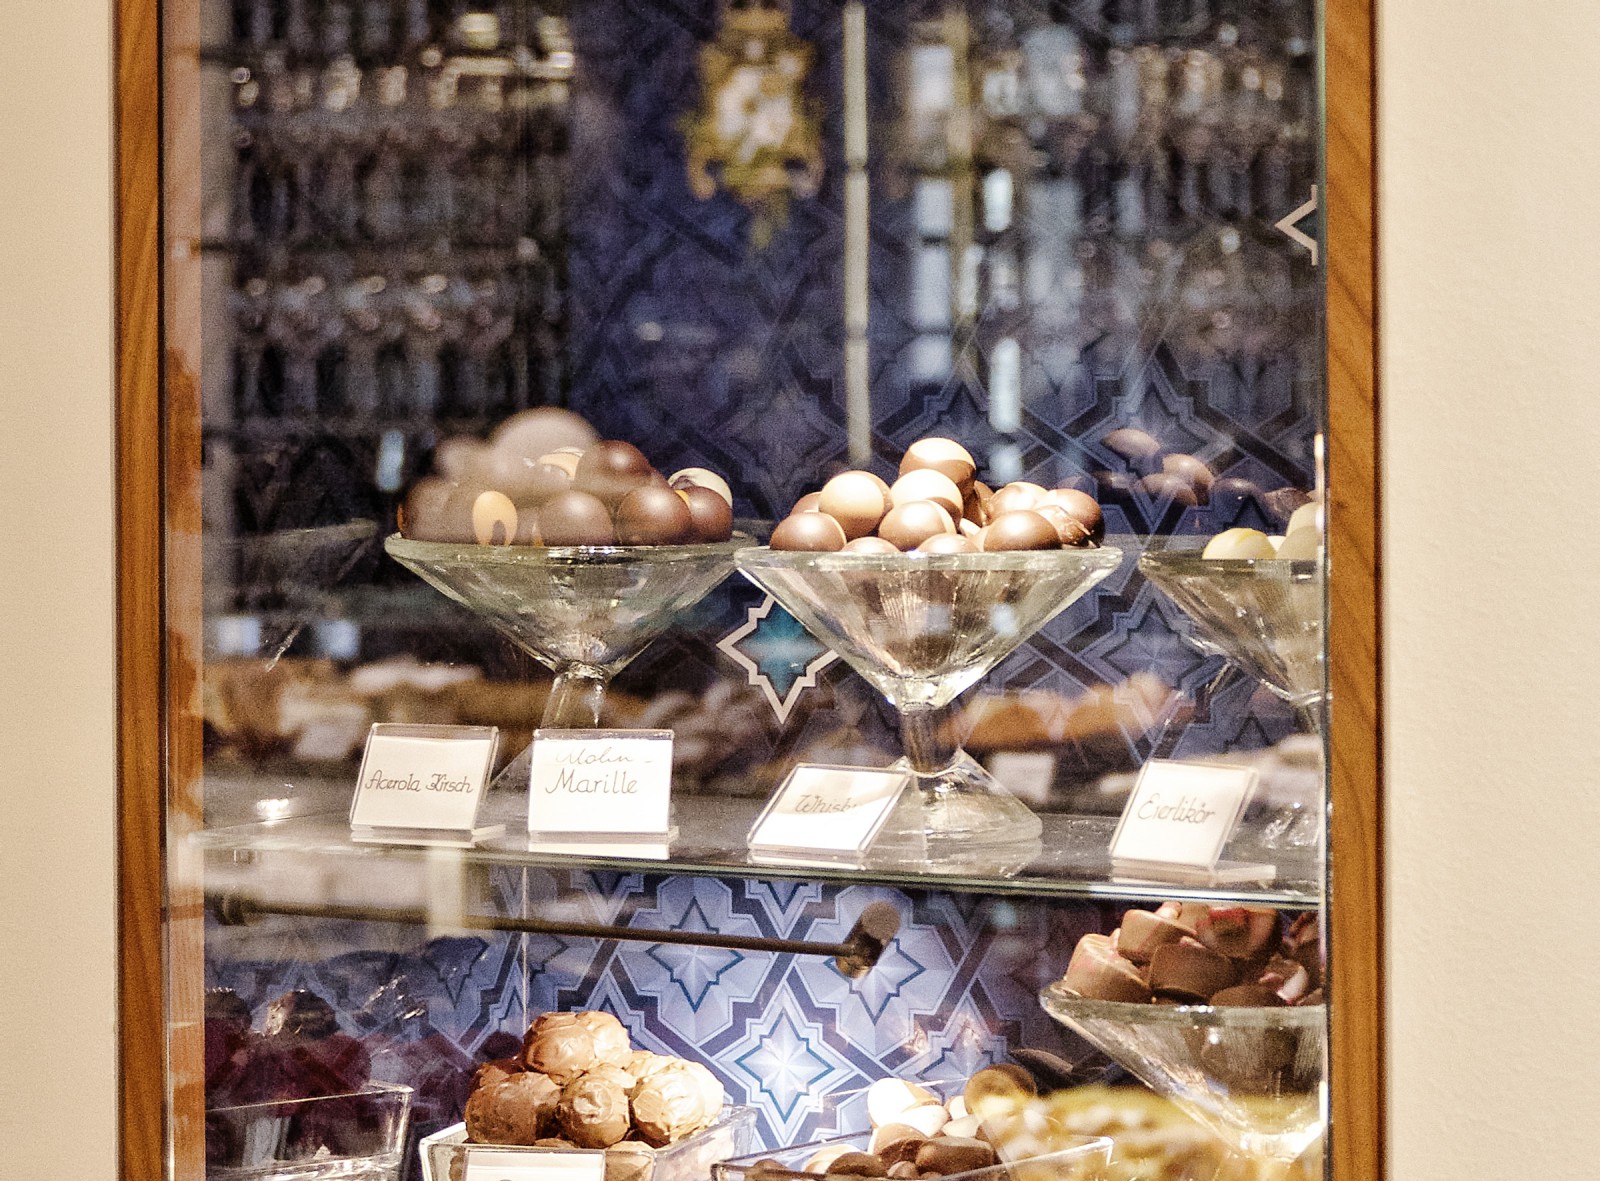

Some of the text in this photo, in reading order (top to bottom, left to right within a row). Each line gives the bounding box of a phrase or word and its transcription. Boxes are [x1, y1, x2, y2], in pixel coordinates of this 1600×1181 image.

[365, 769, 474, 793] Acerola Kirsch
[545, 767, 639, 795] Marille
